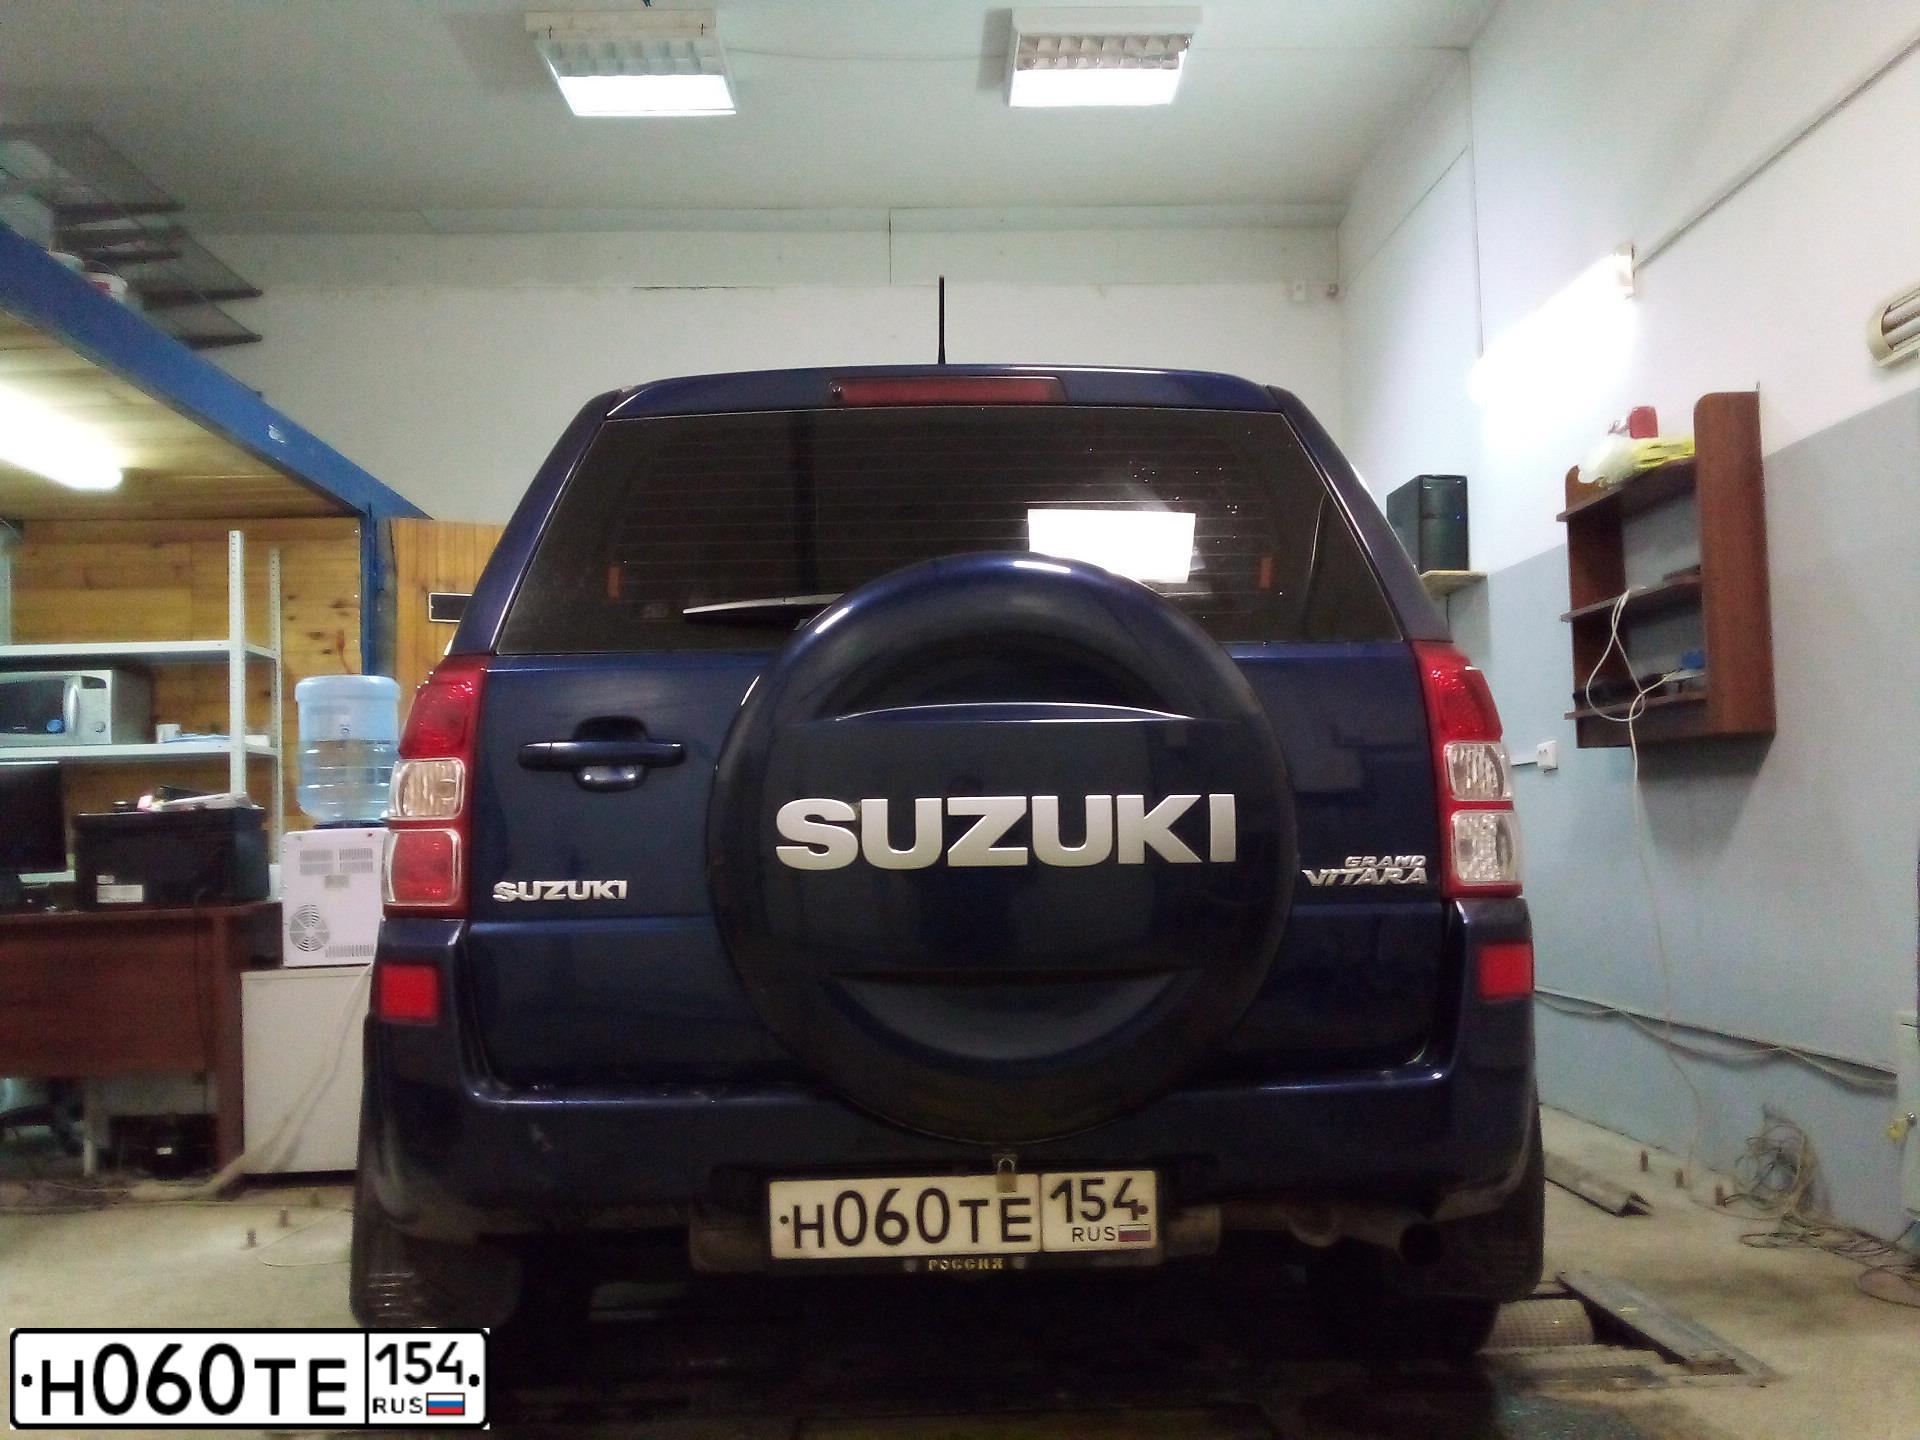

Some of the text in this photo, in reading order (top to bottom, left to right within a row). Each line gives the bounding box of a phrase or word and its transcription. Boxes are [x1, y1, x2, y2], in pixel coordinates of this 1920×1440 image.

[776, 793, 1237, 870] SUZUKI
[1345, 855, 1427, 869] GRAND
[1301, 867, 1428, 887] VITARA
[493, 880, 627, 902] SUZUKI
[1050, 1177, 1139, 1224] 154
[1071, 1225, 1116, 1243] RUS
